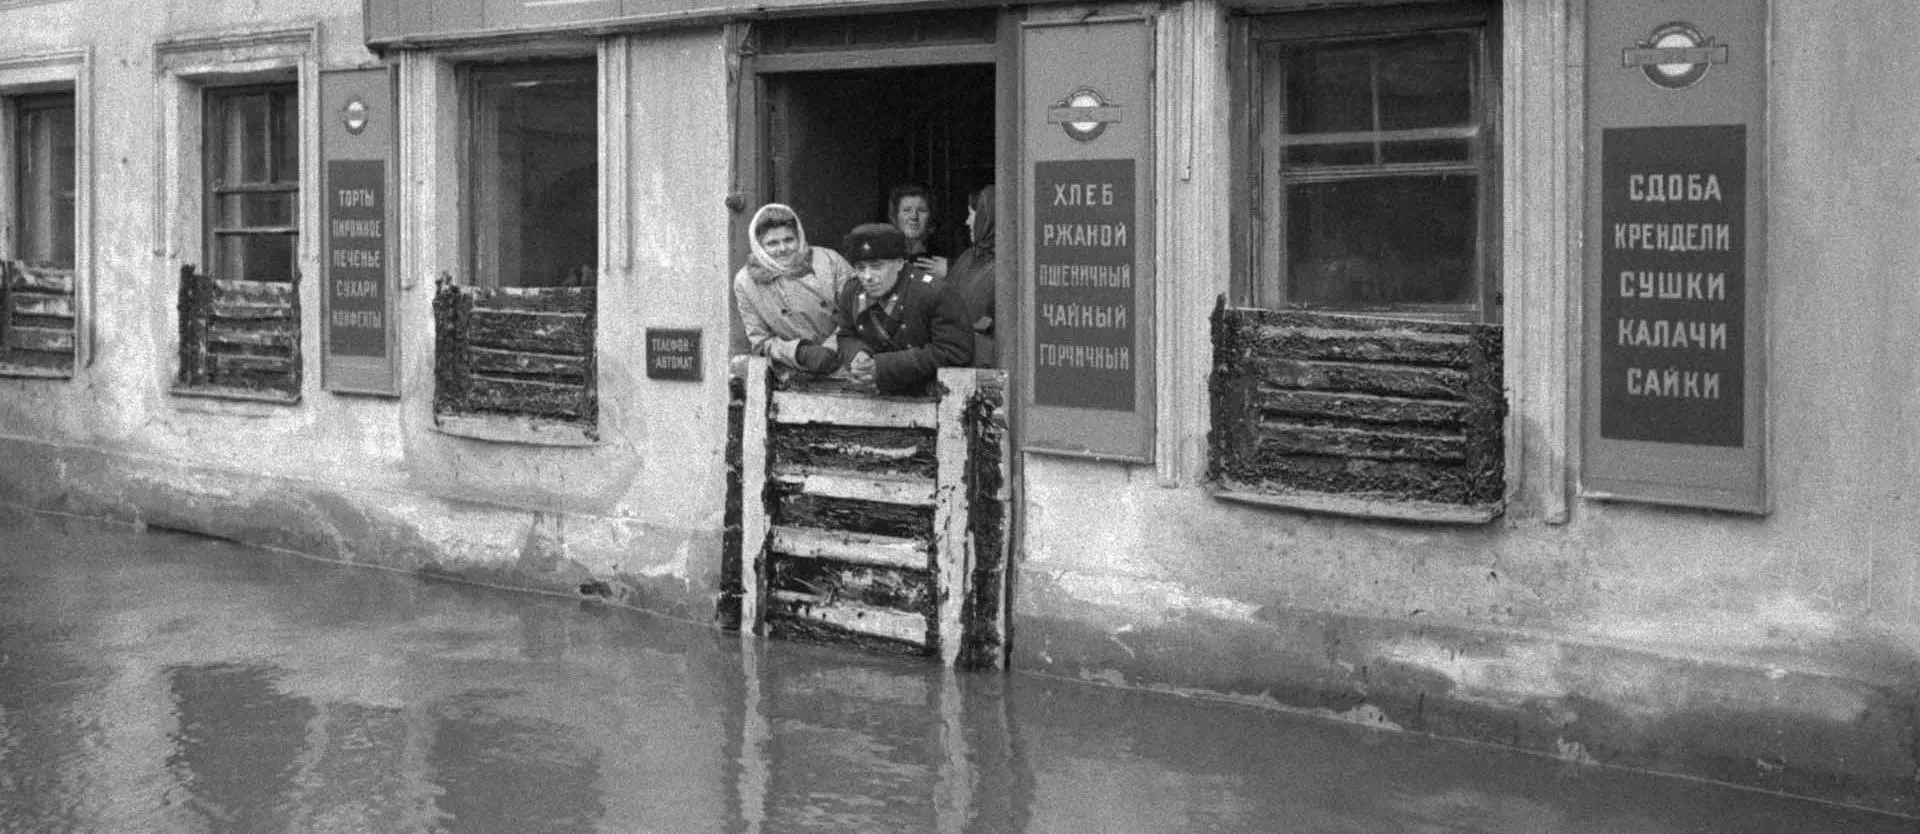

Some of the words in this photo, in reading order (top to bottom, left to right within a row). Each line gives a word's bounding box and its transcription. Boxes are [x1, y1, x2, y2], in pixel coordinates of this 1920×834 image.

[338, 188, 375, 207] ТОРТЫ
[1053, 183, 1114, 206] ХЛЕБ
[1629, 173, 1722, 202] СДОБА
[1043, 222, 1128, 247] РЖАНОЙ
[1614, 223, 1730, 252] КРЕНДЕЛИ
[333, 249, 381, 269] ПЕЧЕНЬЕ
[336, 280, 378, 298] СУХАРИ
[1039, 263, 1131, 289] ПШЕНИЧНЫЙ
[1620, 271, 1726, 300] СУШКИ
[1043, 302, 1127, 329] ЧАЙНЫЙ
[1618, 318, 1727, 351] КАЛАЧИ
[1039, 343, 1130, 370] ГОРЧИЧНЫЙ
[1627, 366, 1721, 399] САЙКИ
